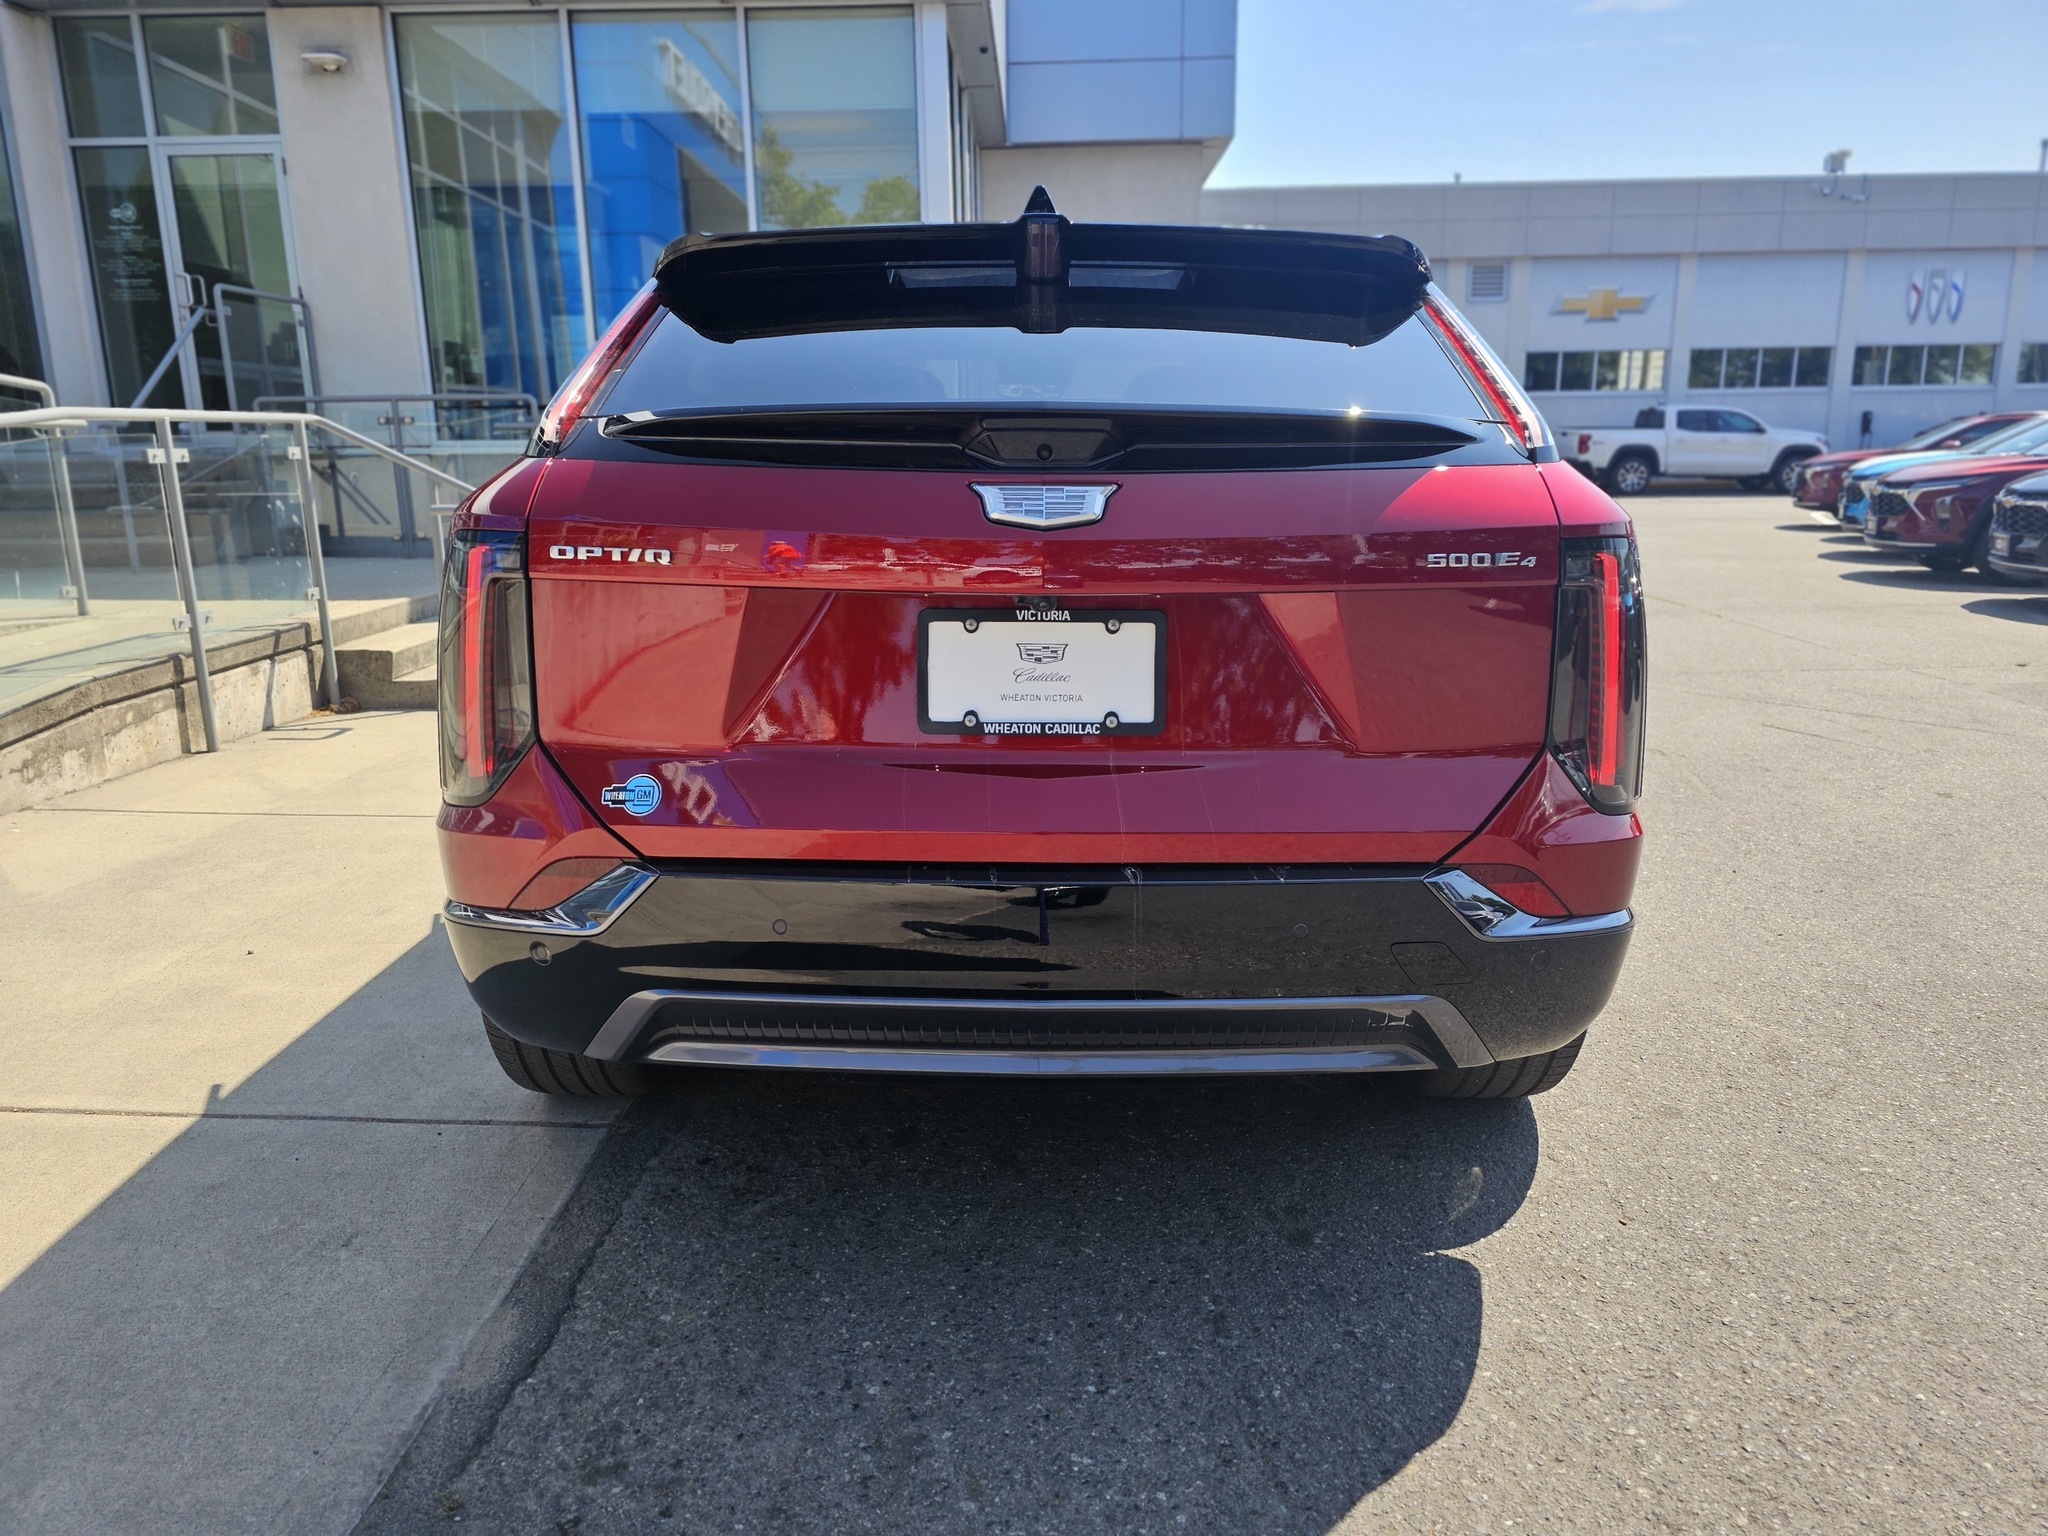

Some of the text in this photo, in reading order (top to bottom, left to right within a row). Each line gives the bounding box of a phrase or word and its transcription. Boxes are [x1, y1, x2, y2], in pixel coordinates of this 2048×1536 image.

[550, 545, 672, 565] OPTIQ
[1016, 609, 1071, 621] VICTORIA
[1012, 667, 1071, 684] Cadillac
[1000, 693, 1083, 702] WHEATON VICTORIA
[983, 723, 1101, 735] WHEATON CADILLAC
[605, 789, 652, 801] WHEATON GM
